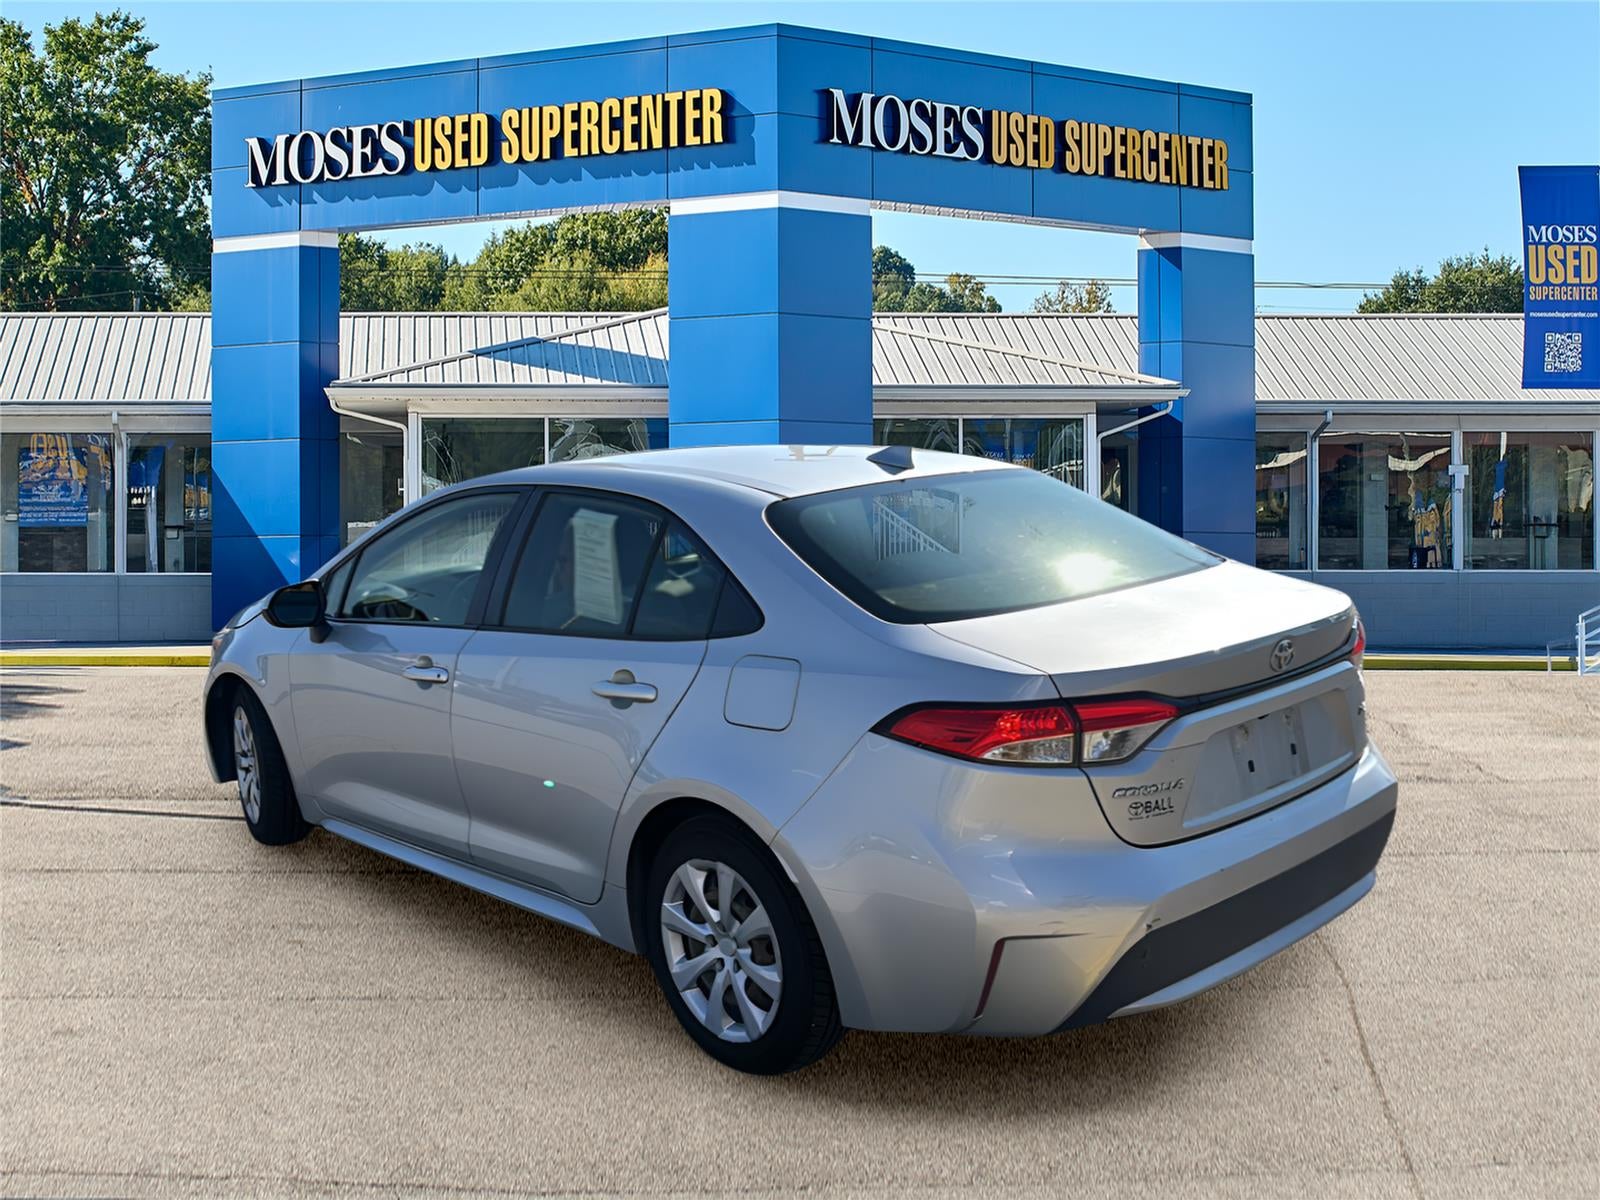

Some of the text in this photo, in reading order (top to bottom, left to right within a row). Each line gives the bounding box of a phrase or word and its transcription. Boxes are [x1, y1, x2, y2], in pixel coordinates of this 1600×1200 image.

[244, 87, 723, 188] MOSES USED SUPERCENTER
[828, 88, 1229, 190] MOSES USED SUPERCENTER
[1527, 224, 1597, 244] MOSES
[1527, 244, 1598, 285] USED
[1529, 285, 1598, 301] SUPERCENTER
[1529, 311, 1598, 319] mosesusedsupercenter.com
[1144, 797, 1175, 814] BALL
